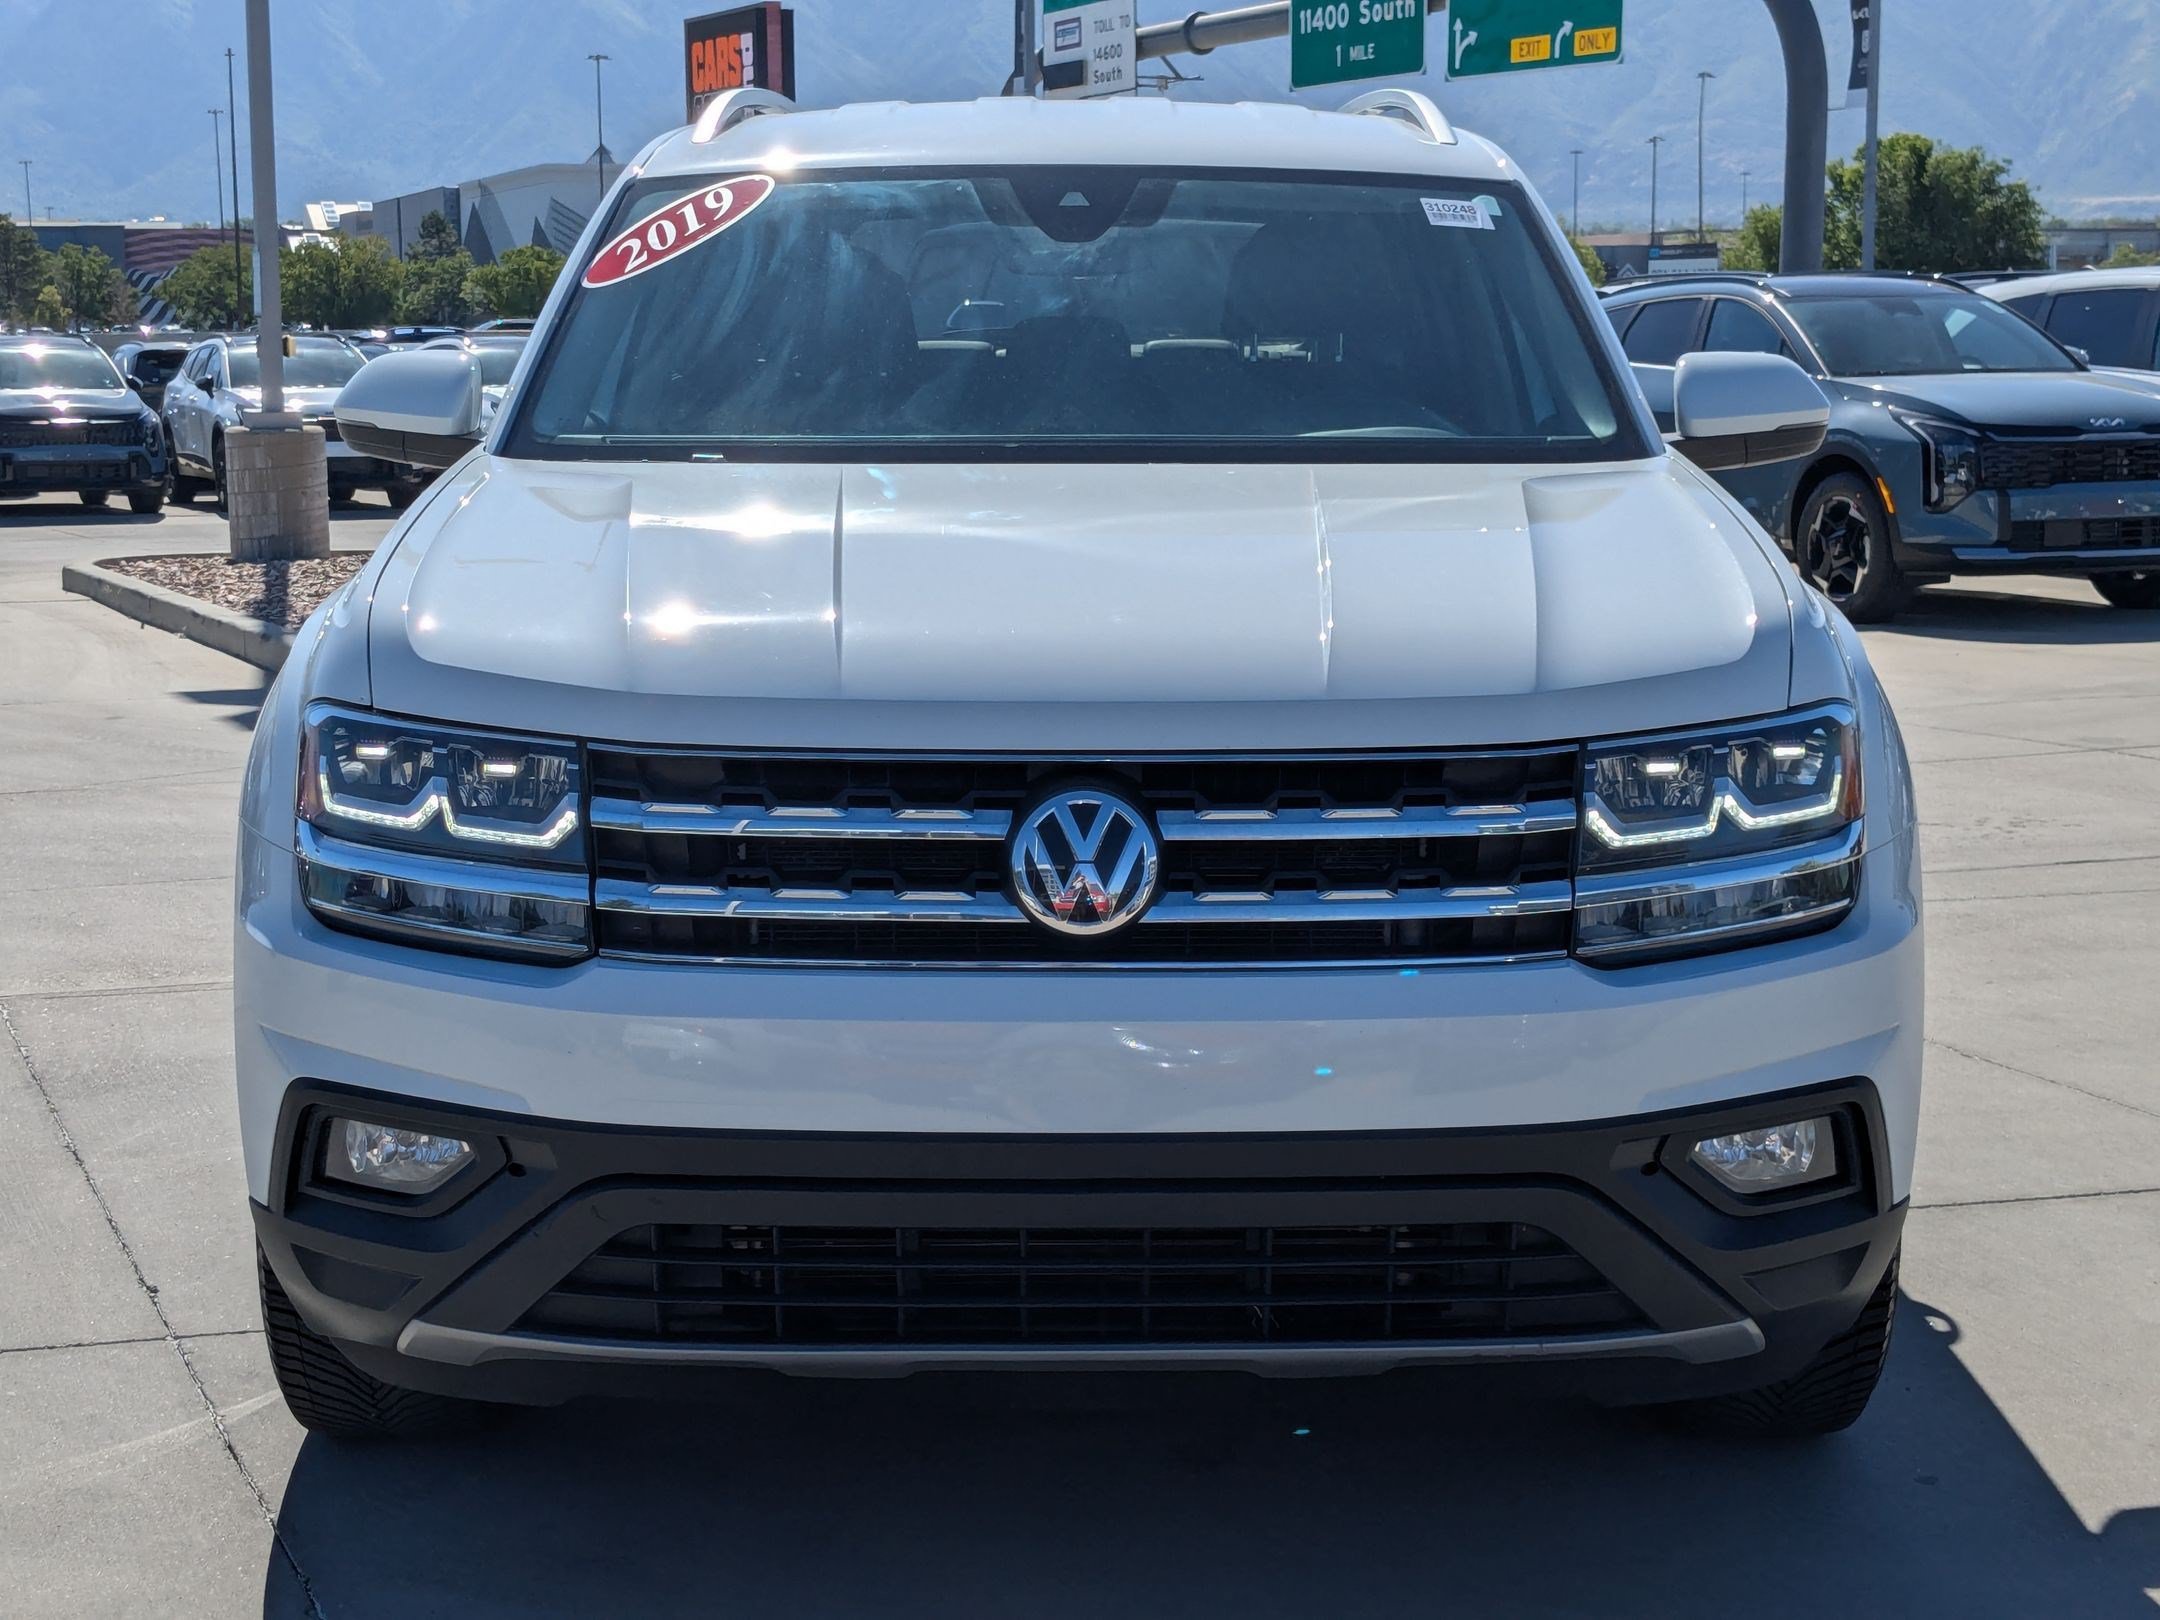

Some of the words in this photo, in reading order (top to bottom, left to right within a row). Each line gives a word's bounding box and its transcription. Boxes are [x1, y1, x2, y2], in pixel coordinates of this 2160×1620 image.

[1093, 17, 1114, 33] TOLL
[1119, 14, 1131, 29] TO
[1300, 3, 1349, 34] 11400
[1359, 0, 1415, 24] South
[1093, 43, 1123, 61] 14600
[1519, 40, 1542, 58] EXIT
[1579, 32, 1611, 52] ONLY
[691, 33, 742, 93] CARS
[1336, 44, 1341, 67] 1
[1349, 43, 1375, 61] MILE
[1093, 66, 1123, 84] South
[1424, 202, 1477, 215] 310248
[617, 187, 733, 273] 2019
[1014, 793, 1156, 931] VW
